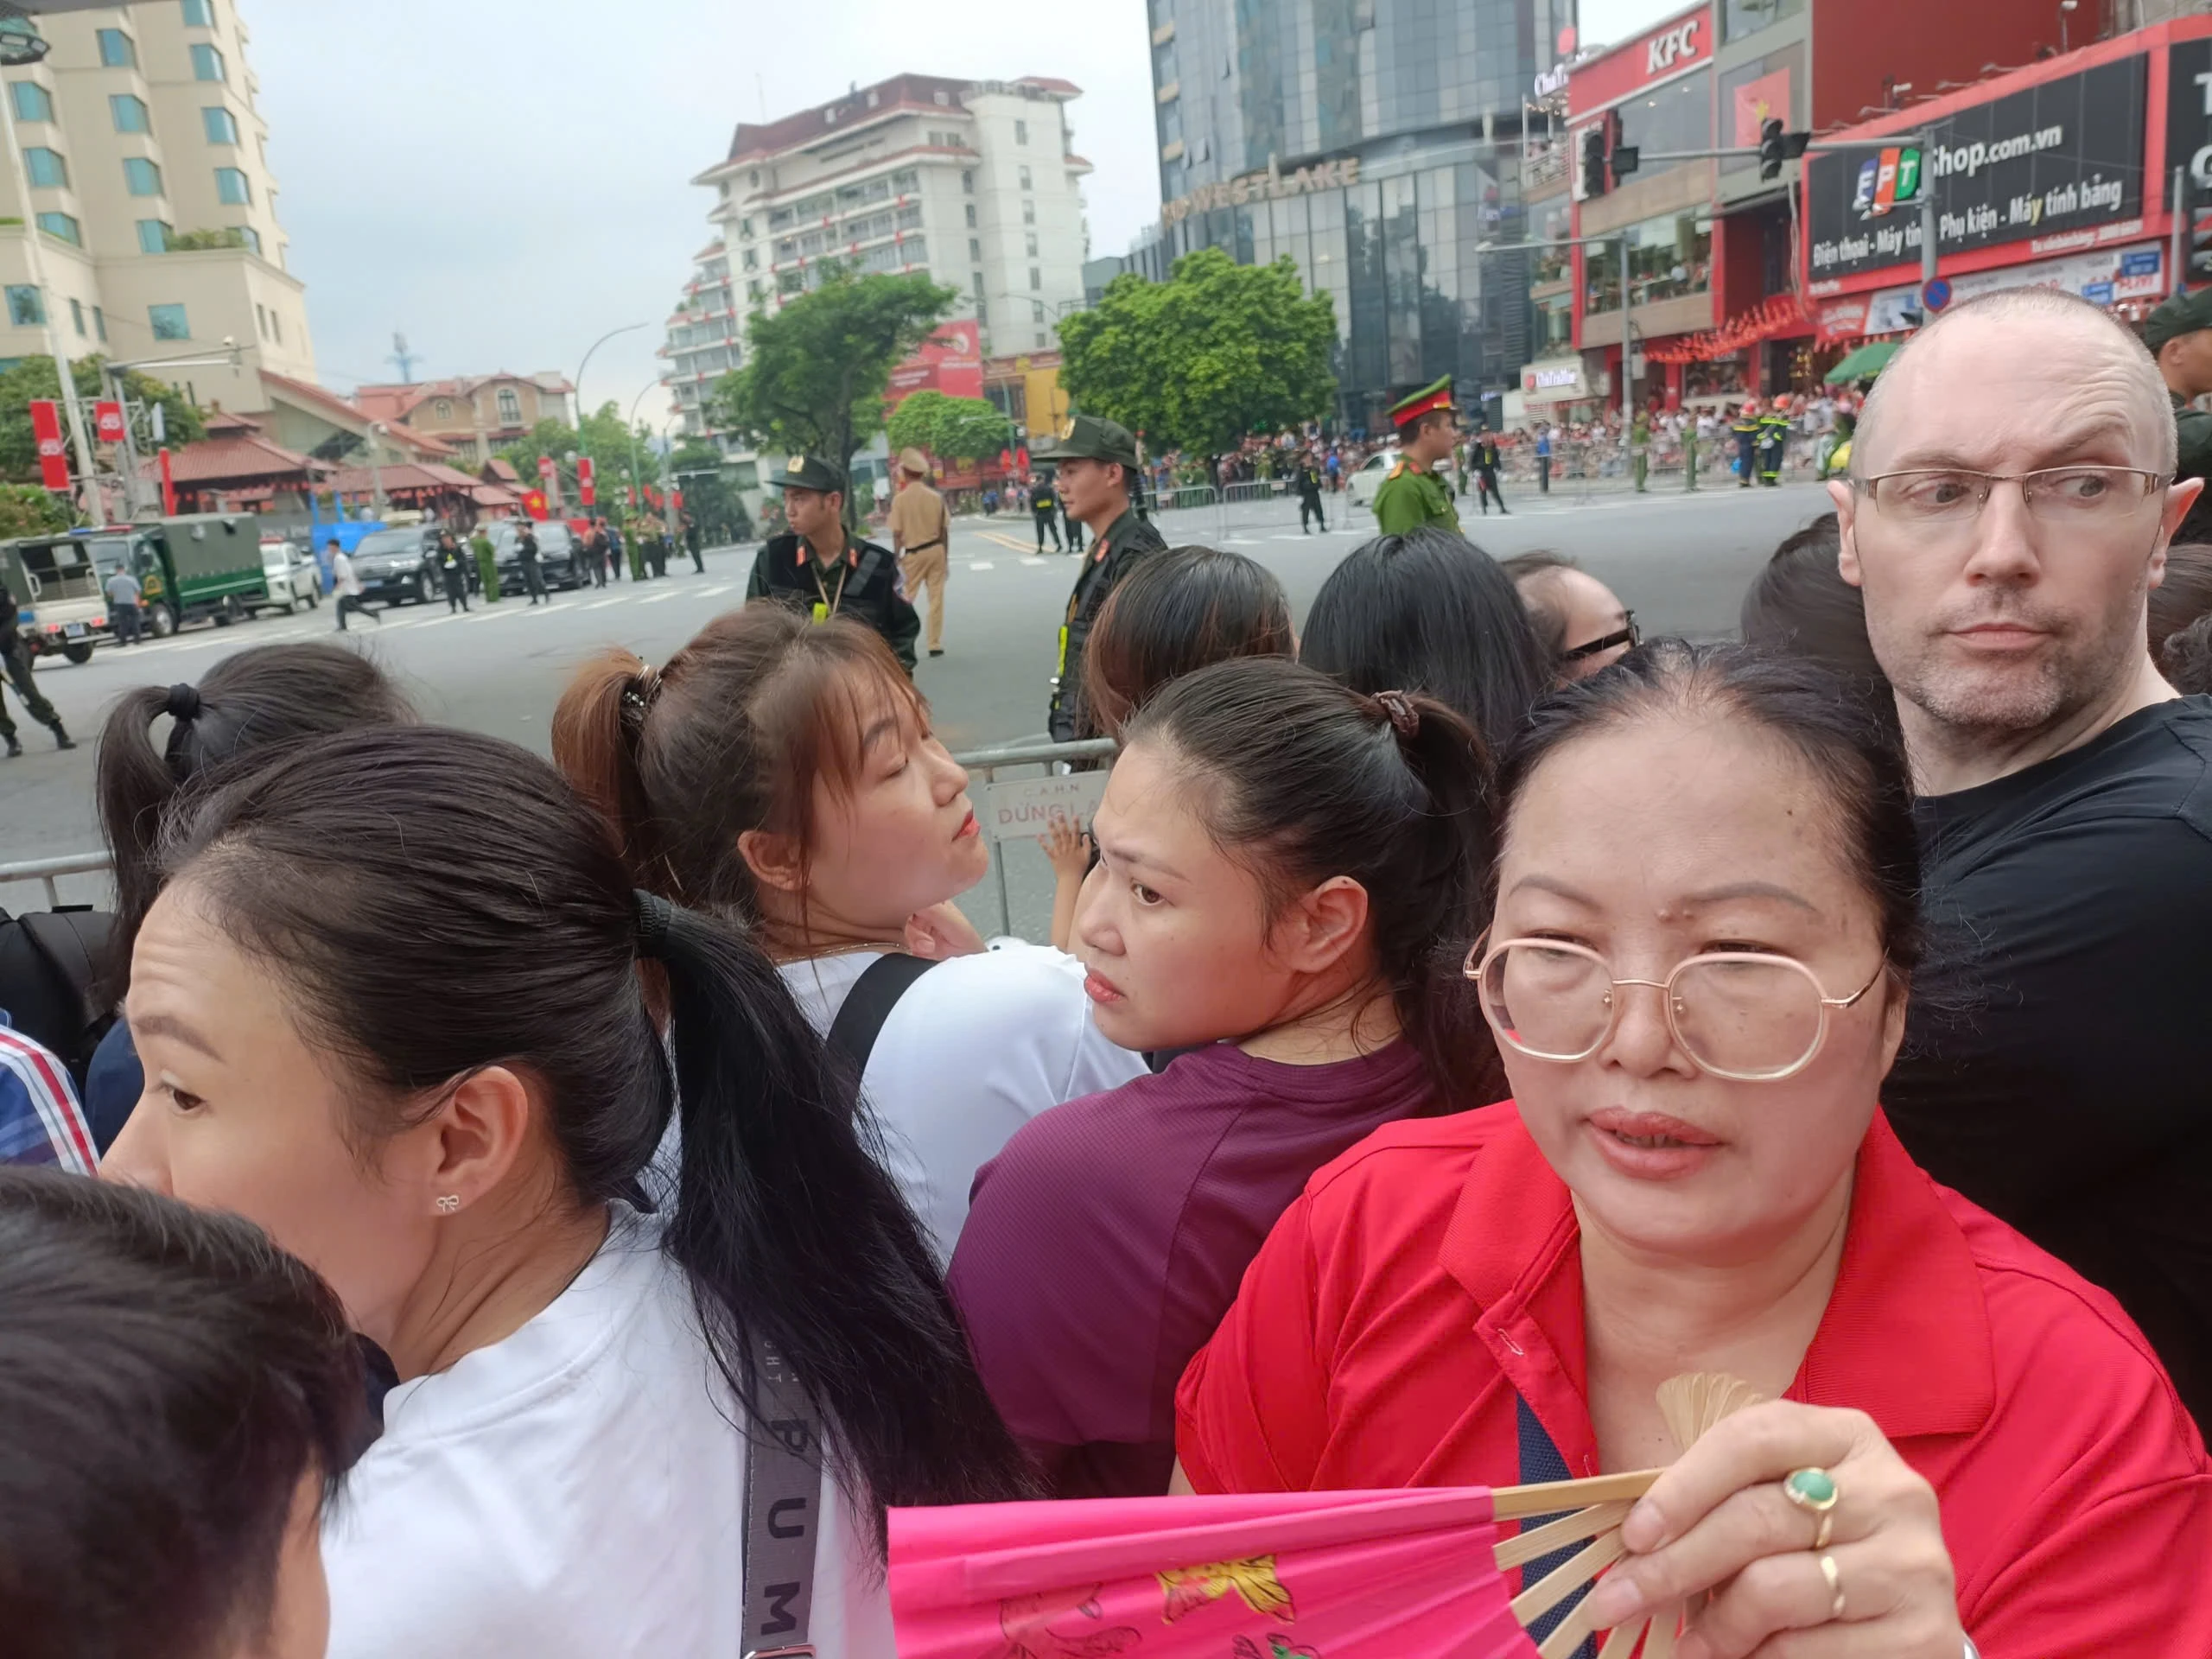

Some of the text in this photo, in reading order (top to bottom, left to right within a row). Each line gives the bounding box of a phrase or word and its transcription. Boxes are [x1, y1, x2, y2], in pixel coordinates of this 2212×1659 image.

[1646, 20, 1700, 75] KFC
[1877, 224, 1904, 257] Máy
[1905, 219, 1923, 248] tín
[1939, 213, 1965, 244] Phụ
[1967, 202, 1998, 239] kiện
[2010, 192, 2043, 227] Máy
[2045, 182, 2077, 217] tính
[2081, 172, 2123, 213] bảng
